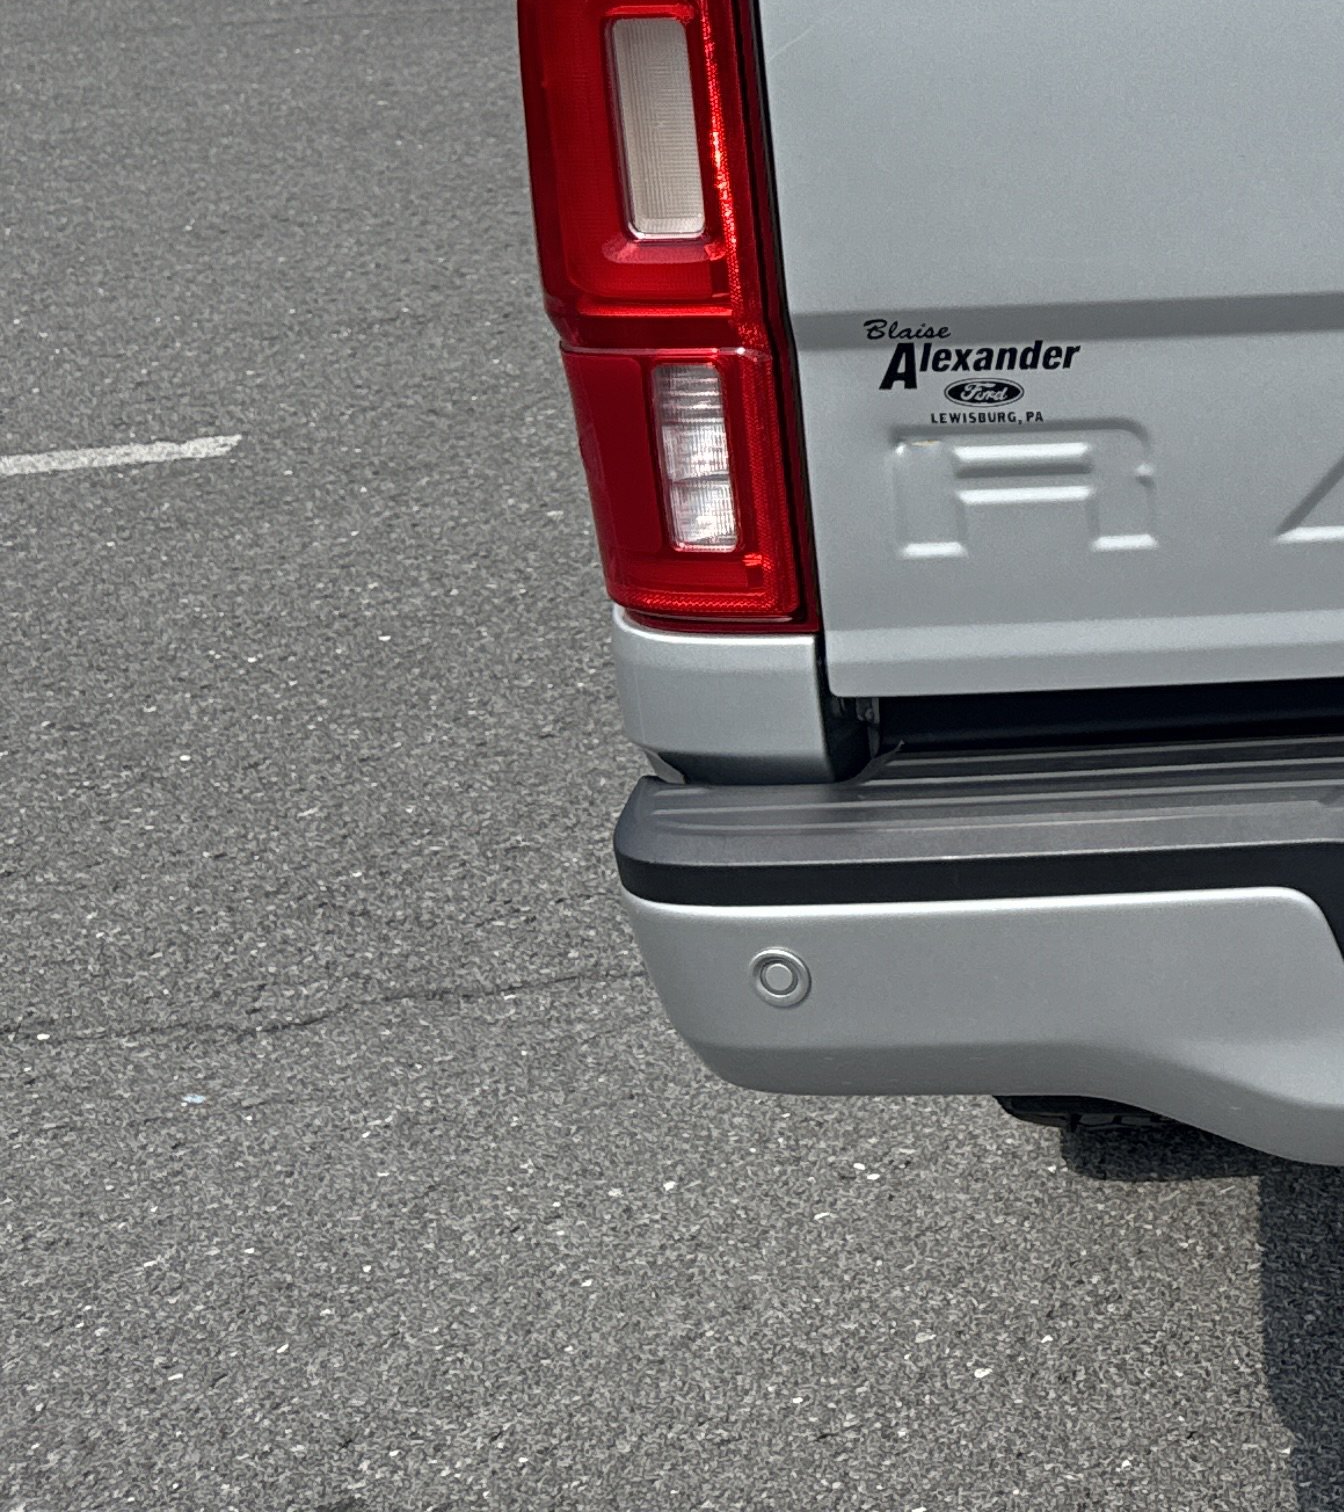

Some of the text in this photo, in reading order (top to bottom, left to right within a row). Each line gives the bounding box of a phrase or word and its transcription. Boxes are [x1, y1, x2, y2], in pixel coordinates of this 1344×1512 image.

[863, 318, 951, 340] Blaise
[879, 340, 1081, 390] Alexander
[960, 381, 1008, 402] Ford
[931, 410, 1044, 425] LEWISBURG, PA
